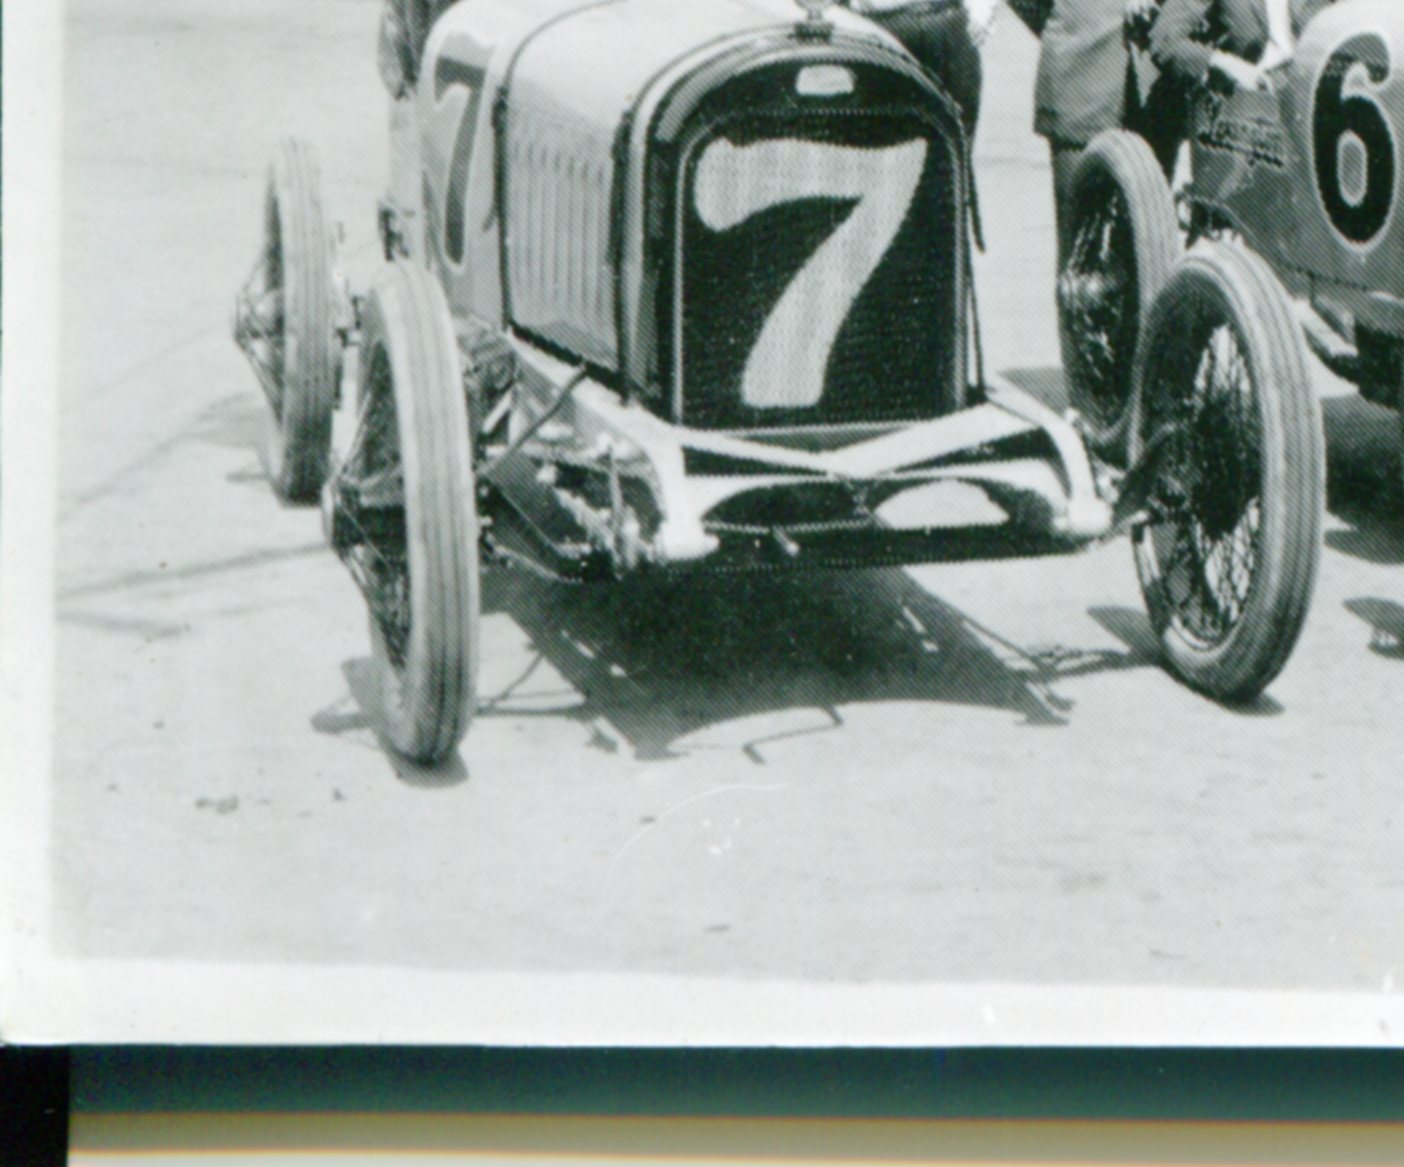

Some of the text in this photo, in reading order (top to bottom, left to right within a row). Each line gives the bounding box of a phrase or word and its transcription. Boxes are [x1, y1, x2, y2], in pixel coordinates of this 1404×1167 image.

[434, 32, 492, 265] 7
[1313, 32, 1395, 245] 6
[693, 137, 928, 408] 7
